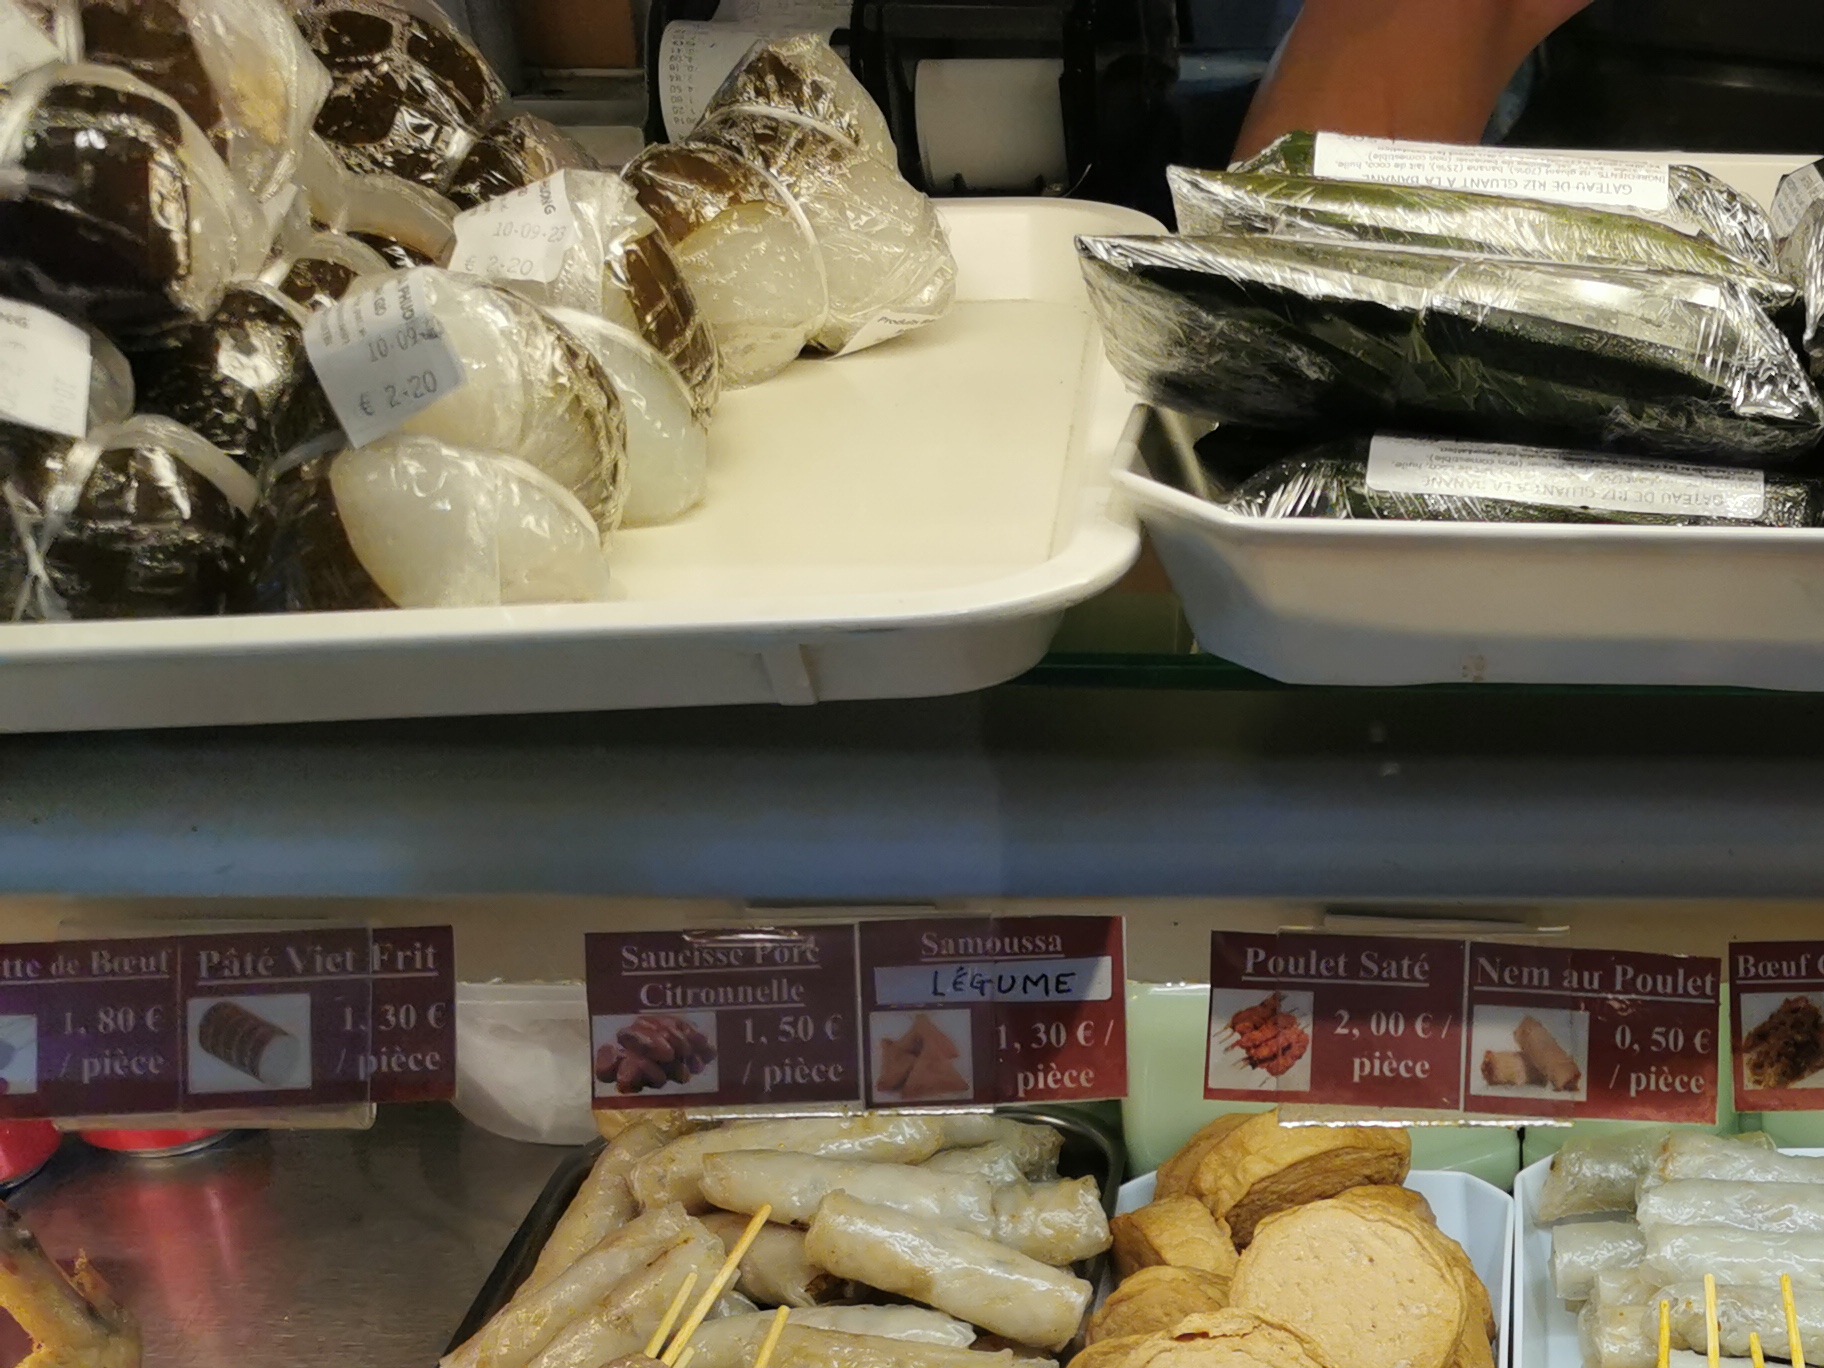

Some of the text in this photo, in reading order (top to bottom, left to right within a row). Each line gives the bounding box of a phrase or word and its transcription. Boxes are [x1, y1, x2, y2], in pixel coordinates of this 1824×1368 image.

[1462, 177, 1518, 189] GLUANT
[1524, 180, 1545, 191] RIZ
[1552, 181, 1570, 192] DE
[200, 941, 437, 978] Pâté Viet Frit
[621, 944, 744, 970] Saucisse
[921, 931, 1064, 957] Samoussa
[1245, 947, 1430, 981] Poulet Saté
[1476, 957, 1716, 997] Nem au Poulet
[640, 978, 806, 1008] Citronnelle
[931, 966, 1077, 997] LÉGUME
[82, 1047, 165, 1084] pièce
[358, 1045, 441, 1081] pièce
[763, 1057, 844, 1093] pièce
[1352, 1051, 1430, 1083] pièce
[1016, 1062, 1095, 1097] pièce
[1629, 1067, 1705, 1097] pièce
